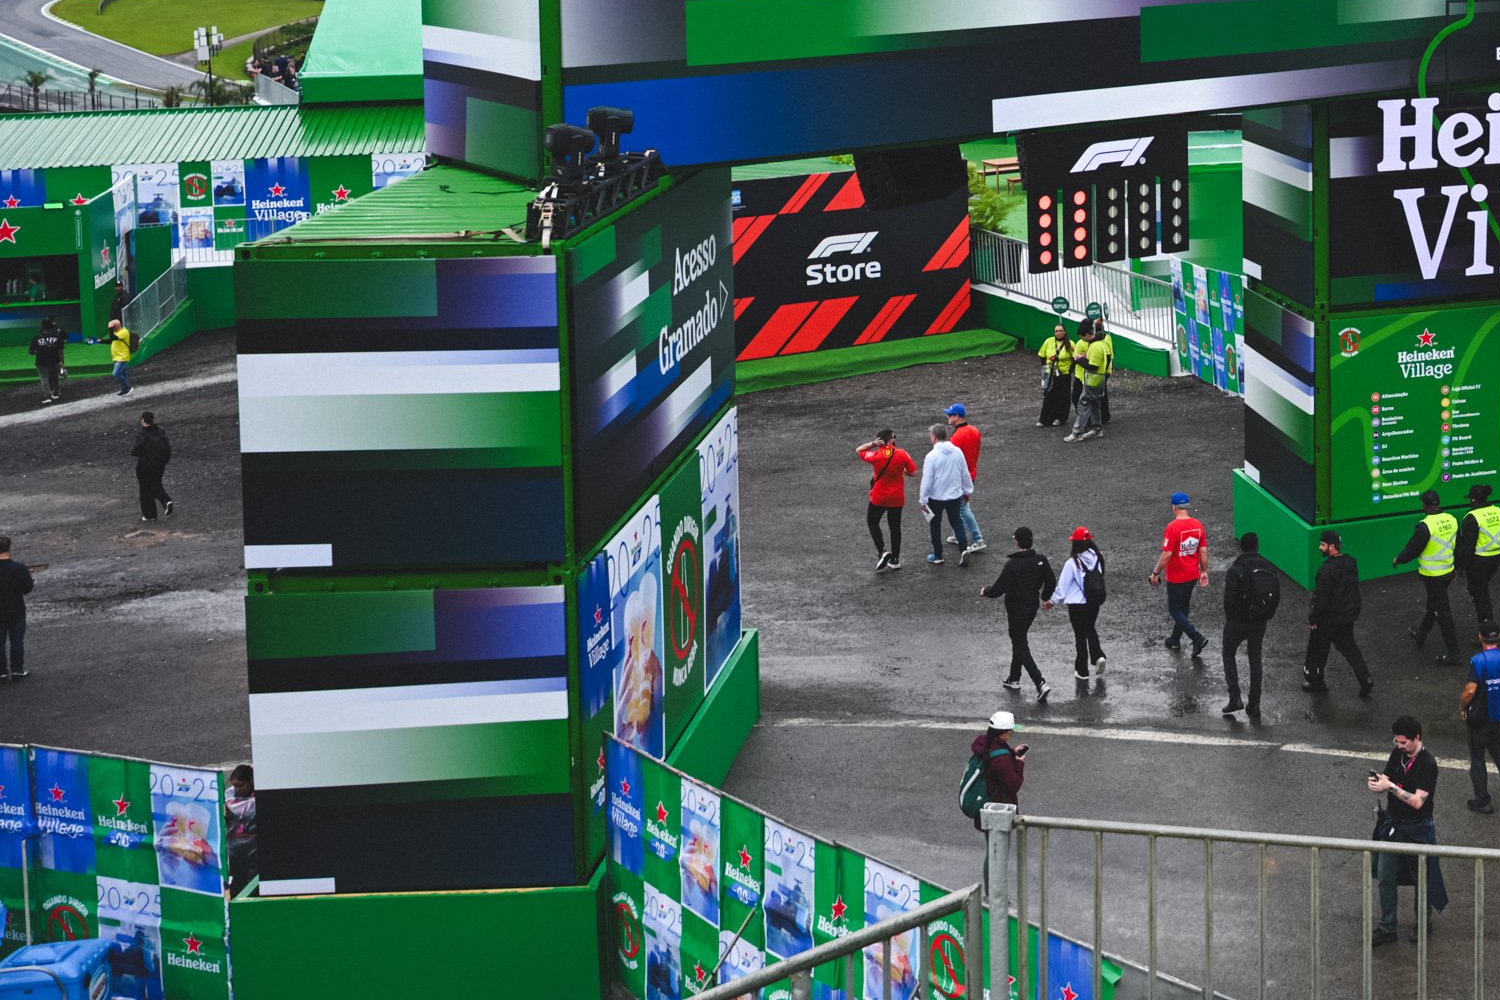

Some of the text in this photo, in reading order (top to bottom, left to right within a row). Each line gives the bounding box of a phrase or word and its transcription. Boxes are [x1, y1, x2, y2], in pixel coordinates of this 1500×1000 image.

[1069, 135, 1155, 173] F1
[252, 197, 304, 210] Heineken
[254, 208, 301, 223] Village
[807, 231, 880, 260] F1
[673, 234, 717, 296] Acesso
[805, 260, 882, 287] Store
[94, 266, 117, 290] Heineken
[658, 289, 719, 376] Gramado
[1397, 348, 1455, 364] Heineken
[1400, 363, 1453, 379] Village
[666, 519, 684, 574] QUANDO
[587, 620, 610, 654] Heineken
[588, 639, 610, 669] Village
[35, 802, 85, 821] Heineken
[611, 792, 641, 821] Heineken
[37, 818, 84, 838] Village
[98, 815, 148, 834] Heineken
[611, 806, 639, 838] Village
[43, 895, 67, 912] QUANDO
[167, 952, 220, 974] Heineken
